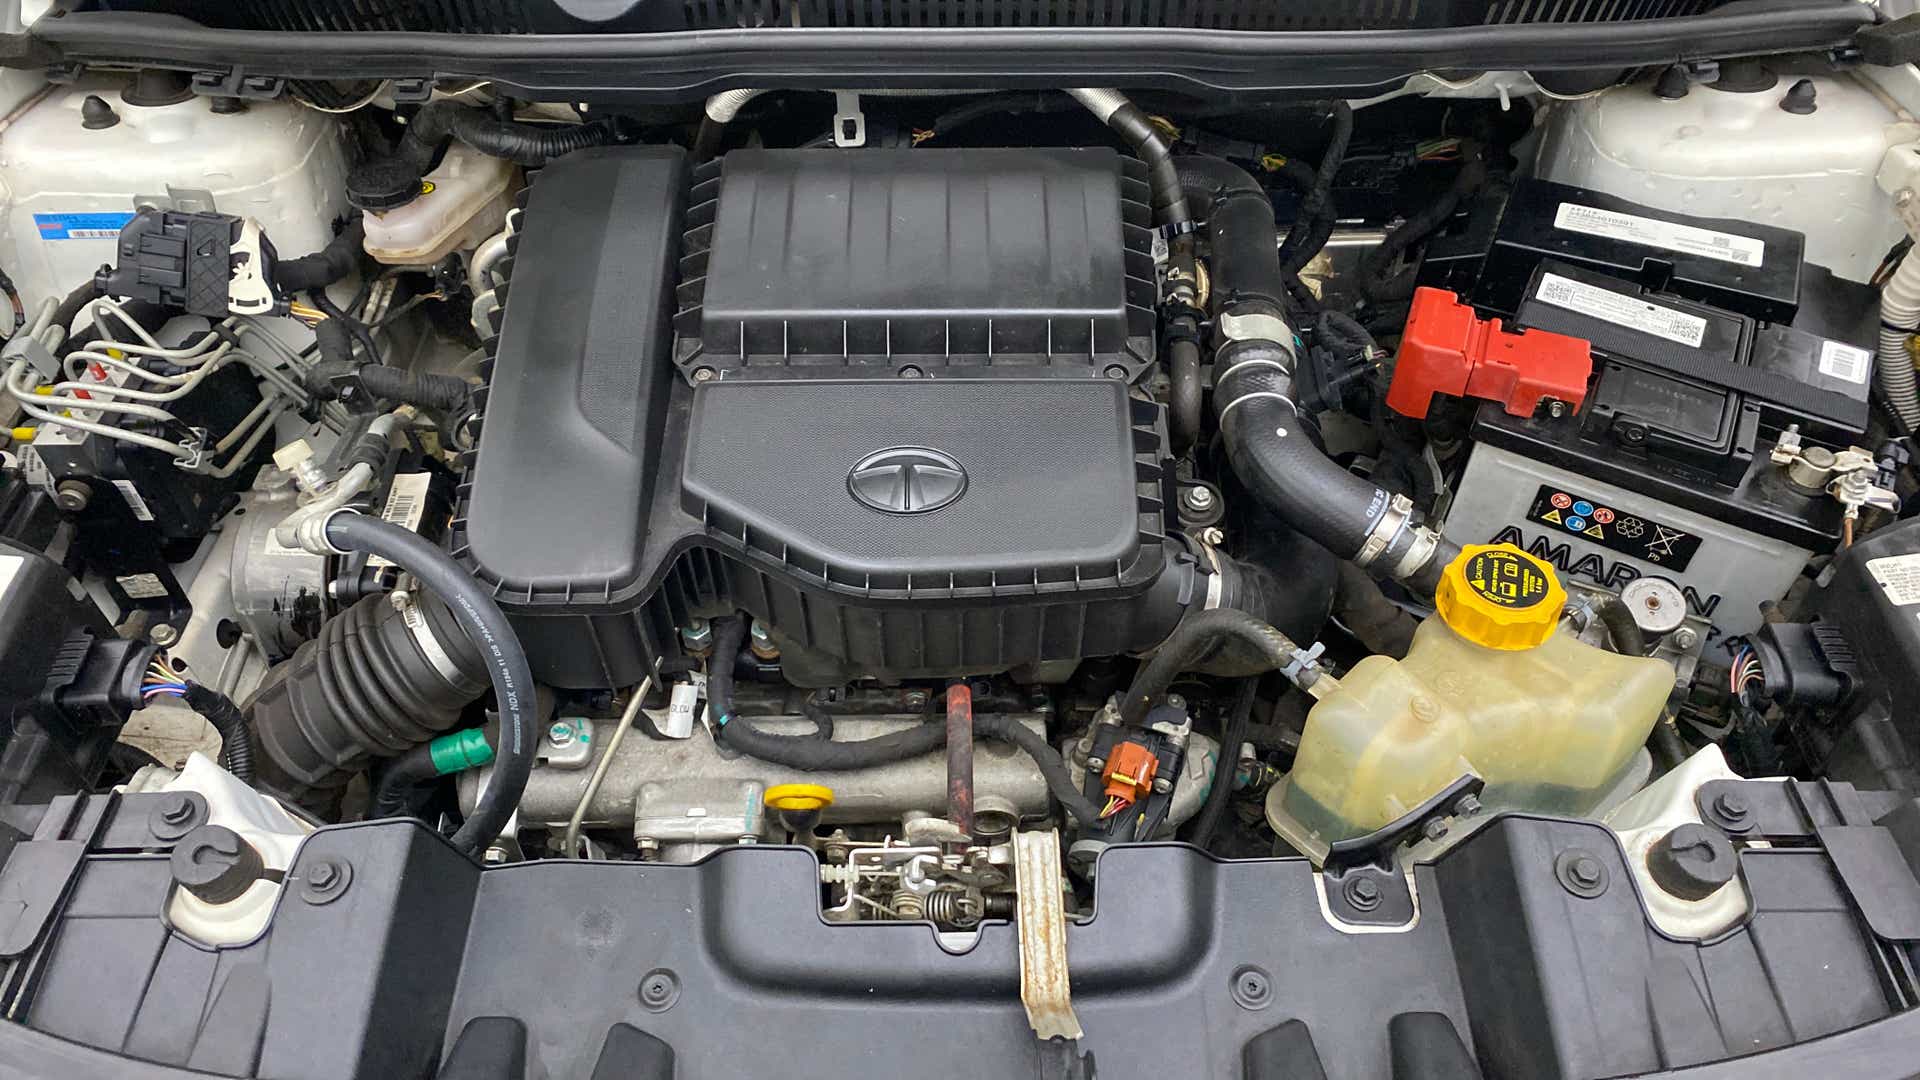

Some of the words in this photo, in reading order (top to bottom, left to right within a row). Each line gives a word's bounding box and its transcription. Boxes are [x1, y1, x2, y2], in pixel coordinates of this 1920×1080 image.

[1366, 497, 1382, 517] END
[1476, 557, 1484, 579] CAUTION
[1488, 525, 1721, 618] AMARN
[506, 691, 519, 711] NDX
